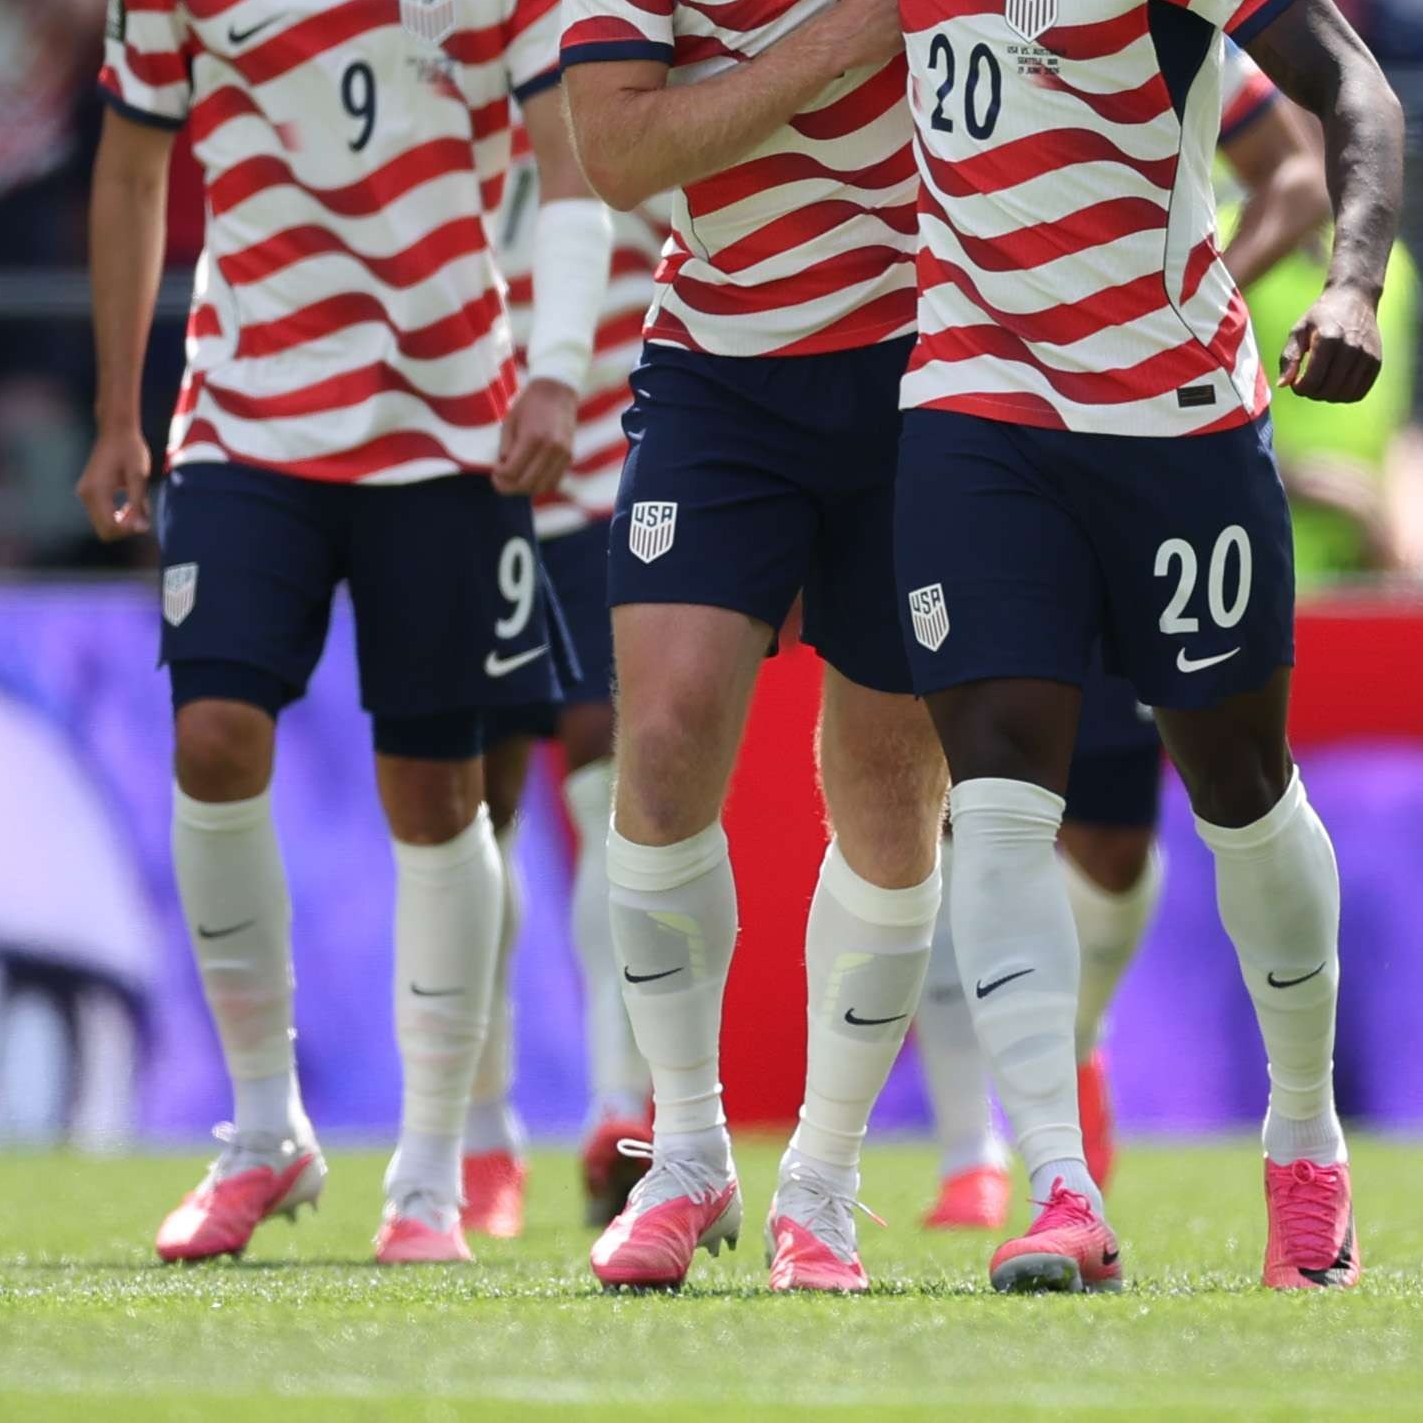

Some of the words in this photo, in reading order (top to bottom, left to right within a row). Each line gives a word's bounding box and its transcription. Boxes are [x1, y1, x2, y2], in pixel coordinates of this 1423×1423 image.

[341, 61, 376, 152] 9
[928, 33, 1002, 140] 20
[635, 505, 673, 527] USA
[494, 536, 535, 639] 9
[911, 587, 941, 615] USA
[1153, 524, 1253, 635] 20
